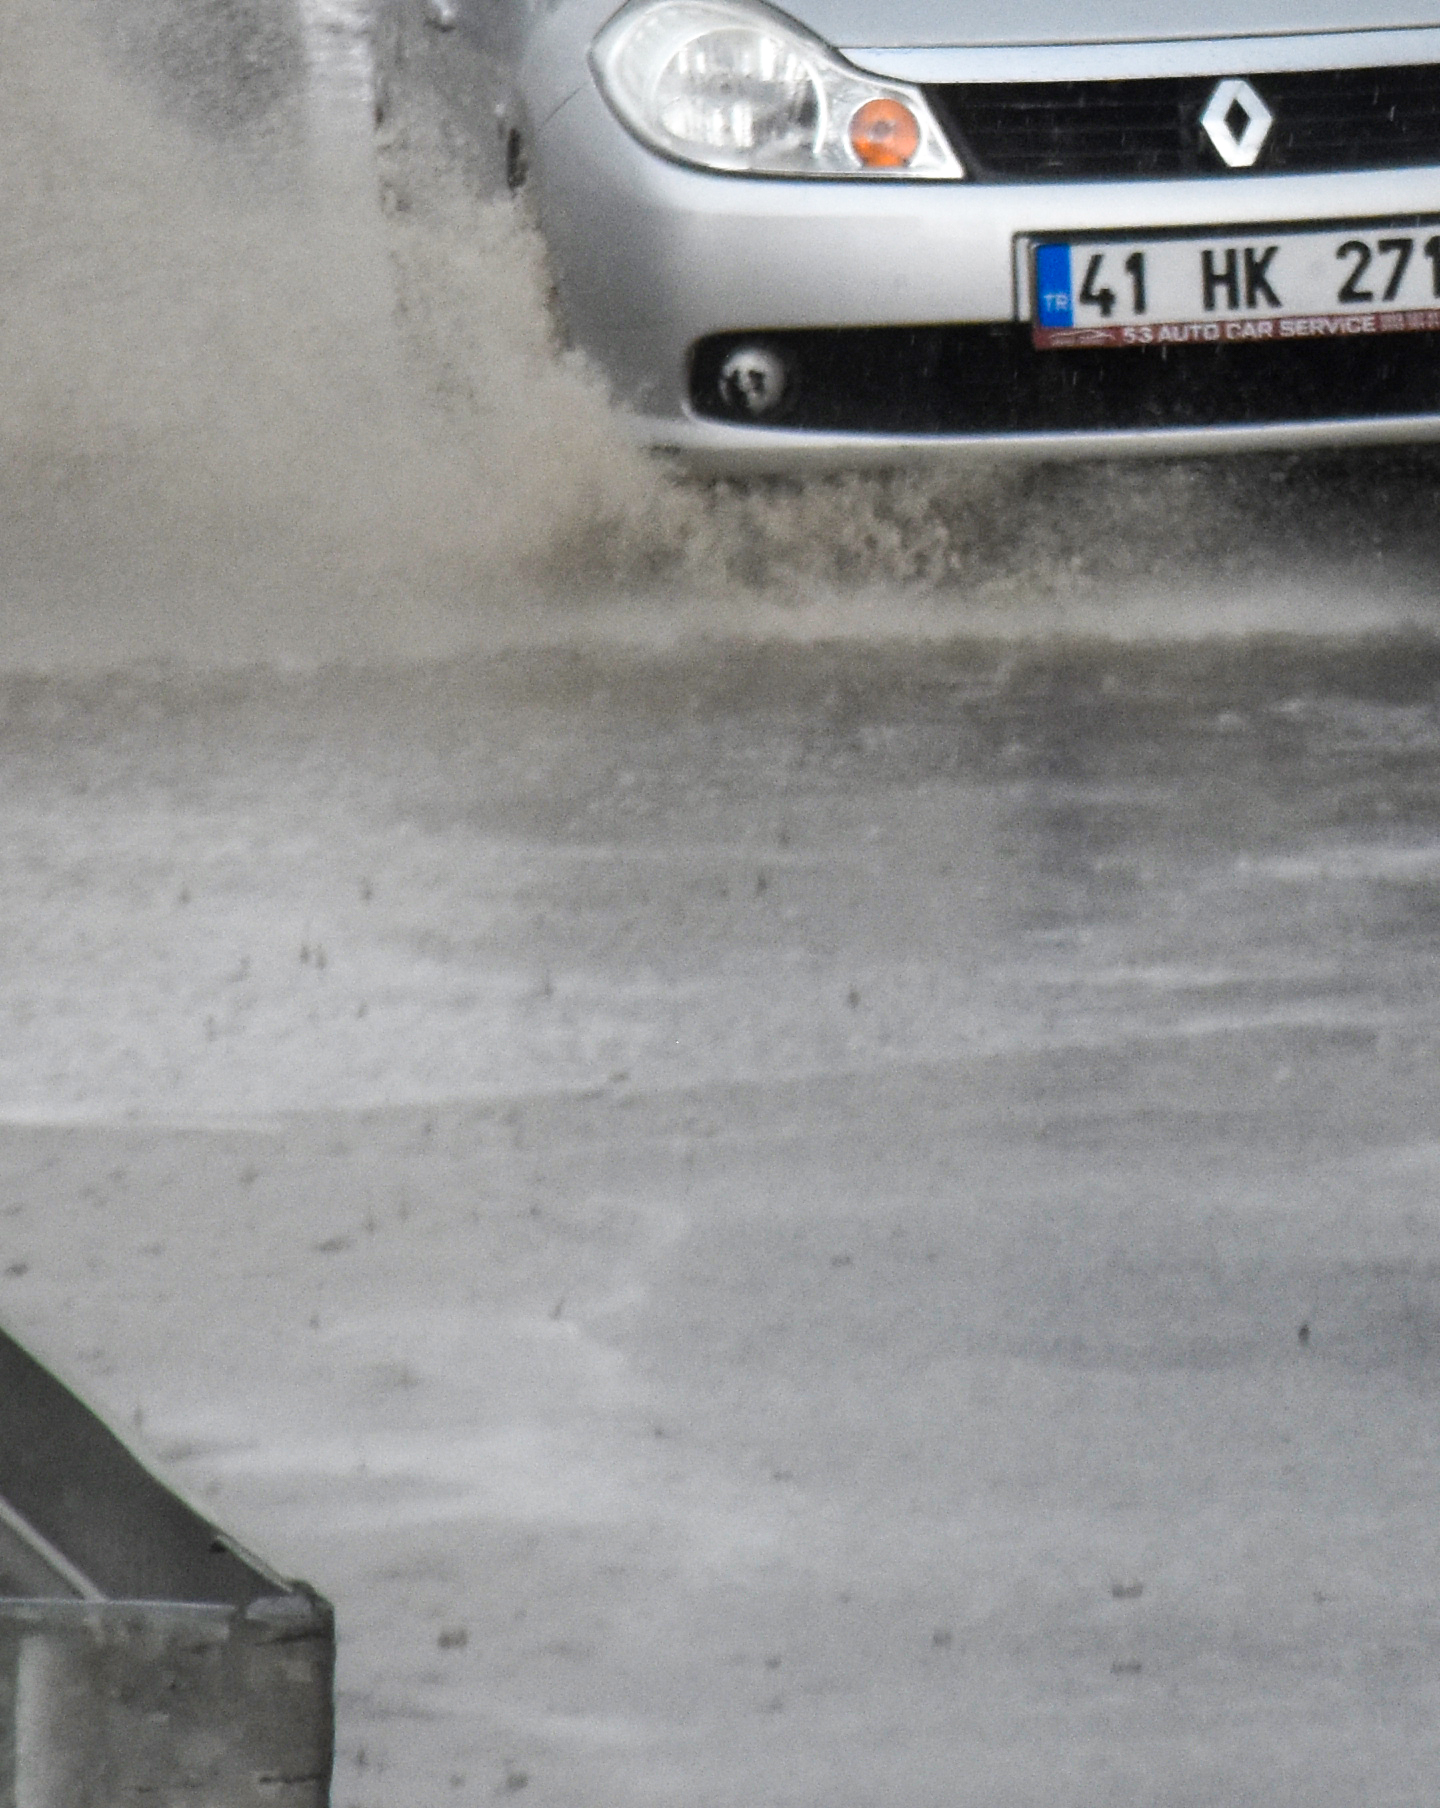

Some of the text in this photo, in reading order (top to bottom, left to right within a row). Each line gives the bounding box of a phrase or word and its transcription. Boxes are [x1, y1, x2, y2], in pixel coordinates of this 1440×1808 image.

[1078, 251, 1148, 317] 41
[1200, 245, 1282, 312] HK
[1158, 323, 1219, 342] AUTO
[1226, 319, 1273, 339] CAR
[1279, 314, 1376, 337] SERVICE
